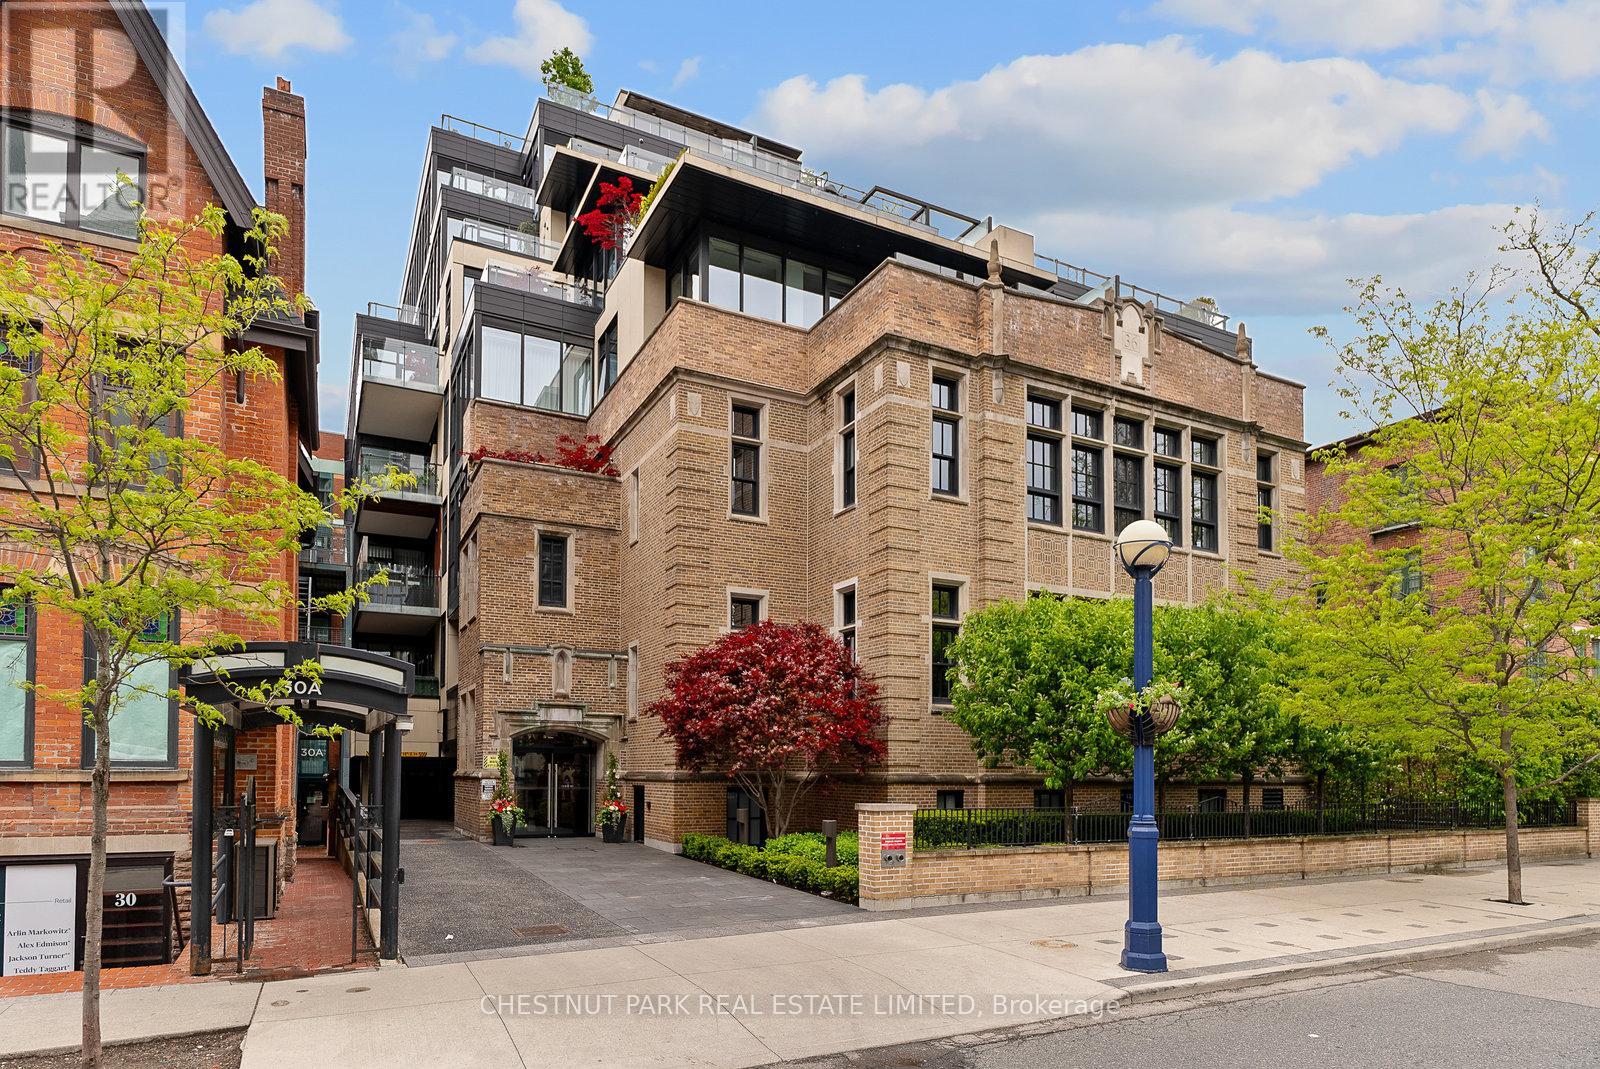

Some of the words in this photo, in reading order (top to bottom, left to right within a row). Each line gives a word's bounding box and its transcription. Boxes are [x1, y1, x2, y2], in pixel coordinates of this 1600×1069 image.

[301, 748, 324, 757] 30A
[114, 892, 137, 907] 30
[8, 955, 38, 964] Jackson
[15, 966, 38, 974] Teddy
